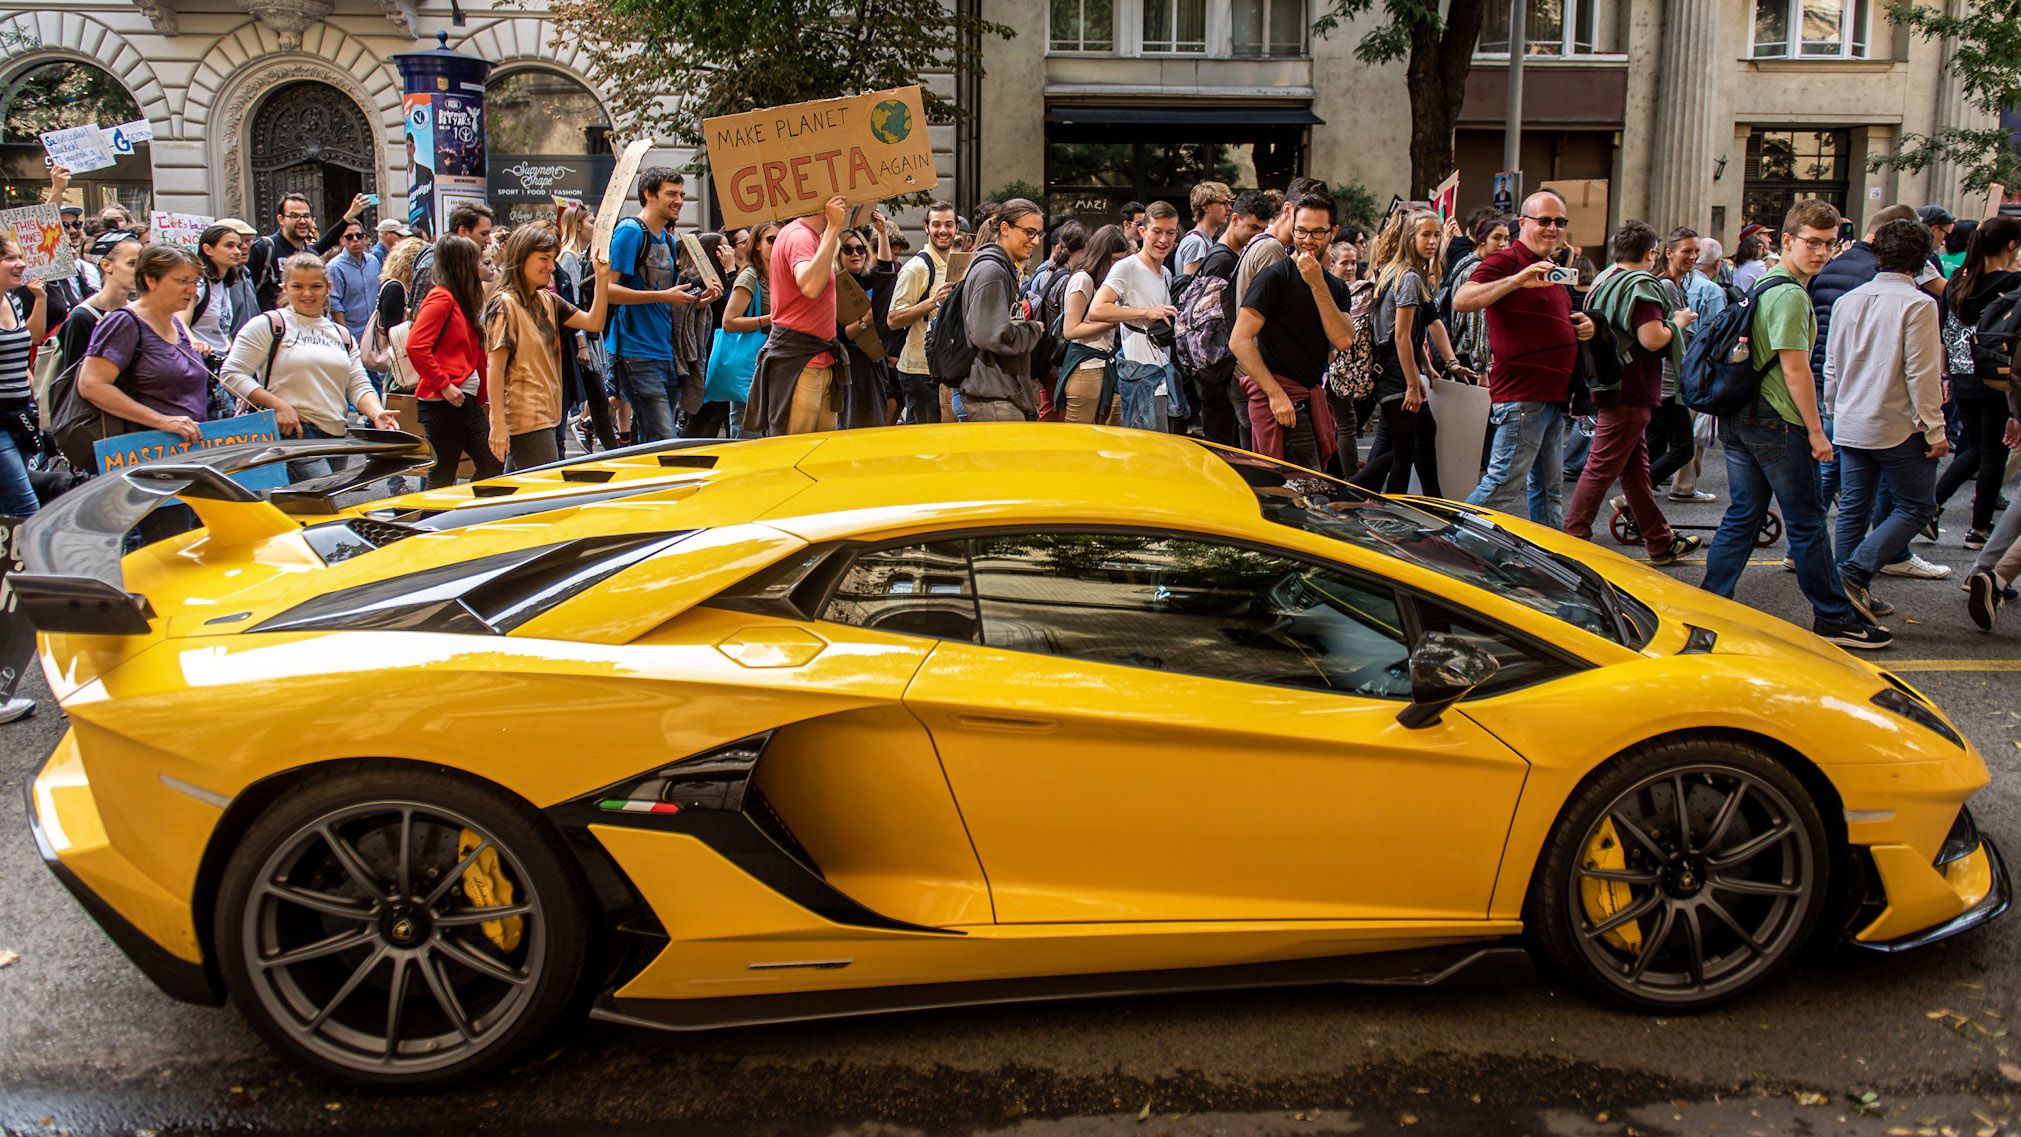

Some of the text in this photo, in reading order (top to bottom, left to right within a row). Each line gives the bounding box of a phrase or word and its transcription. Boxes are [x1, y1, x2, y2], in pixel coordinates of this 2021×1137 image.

[718, 107, 848, 150] MAKE PLANET
[503, 161, 577, 179] Summer
[520, 176, 553, 189] Shape
[730, 146, 930, 213] GRETA AGAIN
[12, 220, 36, 233] THIS
[19, 231, 43, 244] MAKES
[23, 245, 35, 256] ME
[28, 255, 45, 268] SAD
